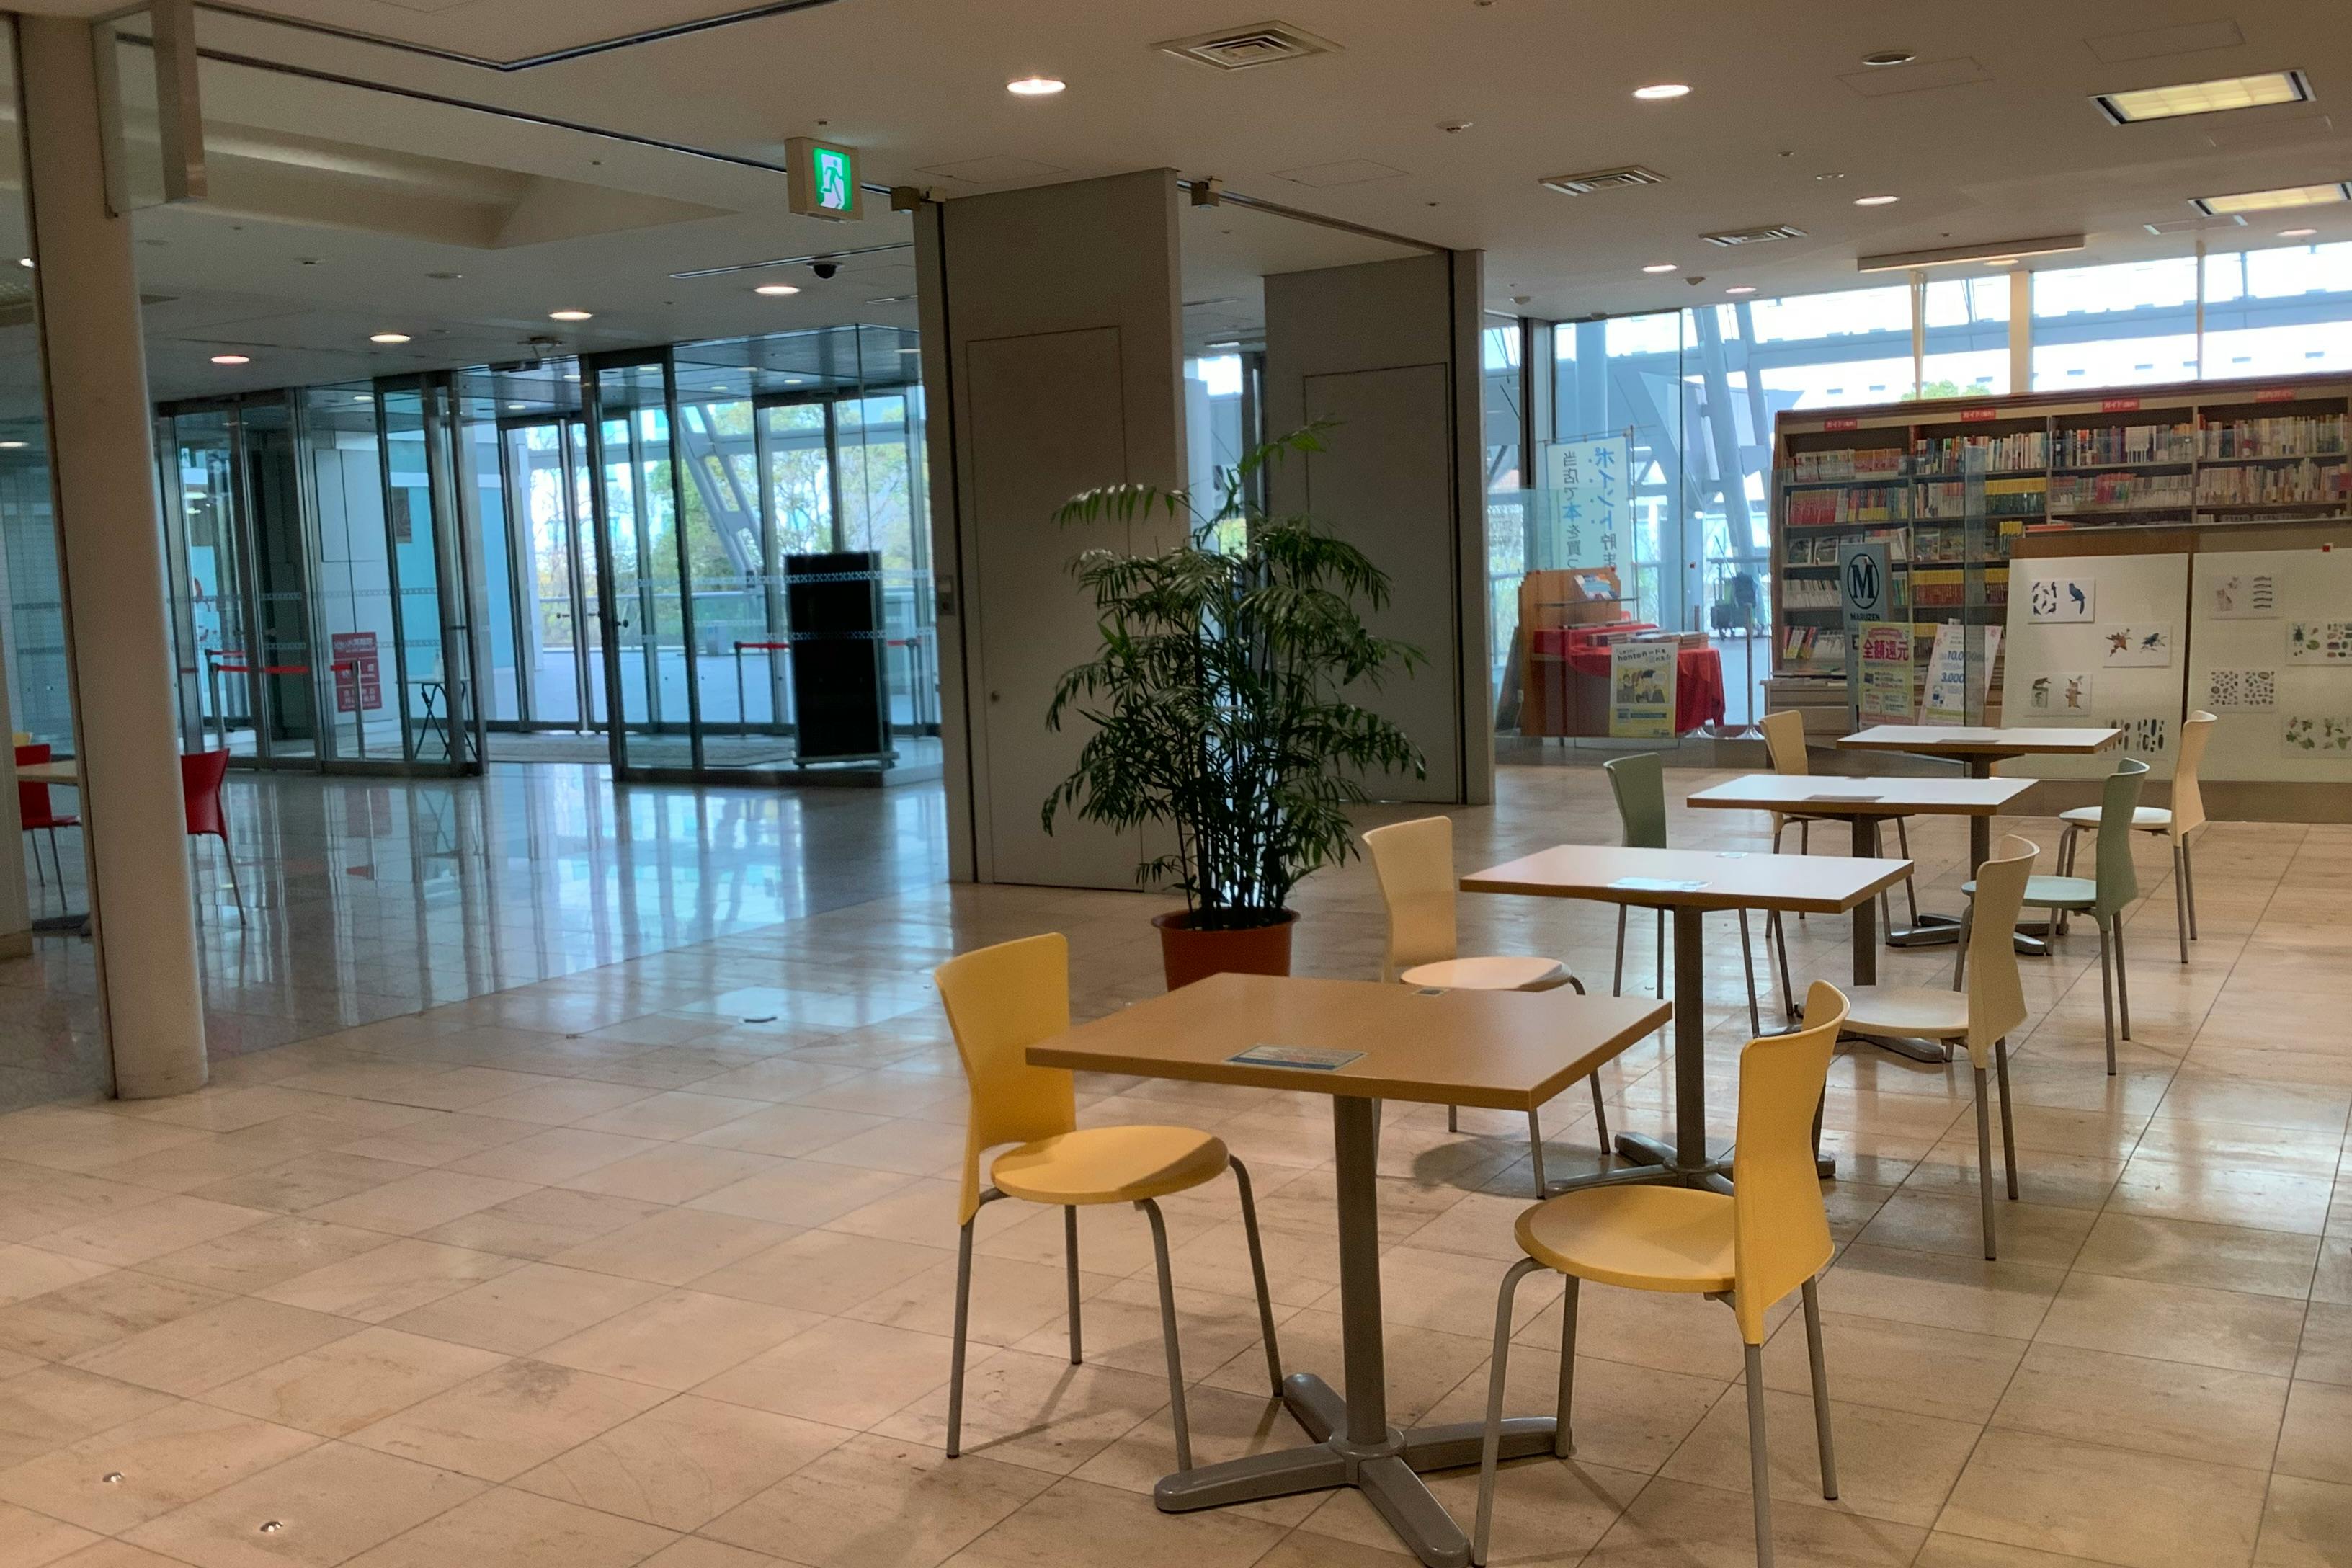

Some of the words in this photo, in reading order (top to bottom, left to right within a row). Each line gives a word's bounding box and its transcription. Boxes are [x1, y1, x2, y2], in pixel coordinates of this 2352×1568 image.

[1851, 564, 1874, 599] M
[1863, 638, 1909, 661] 全額還元
